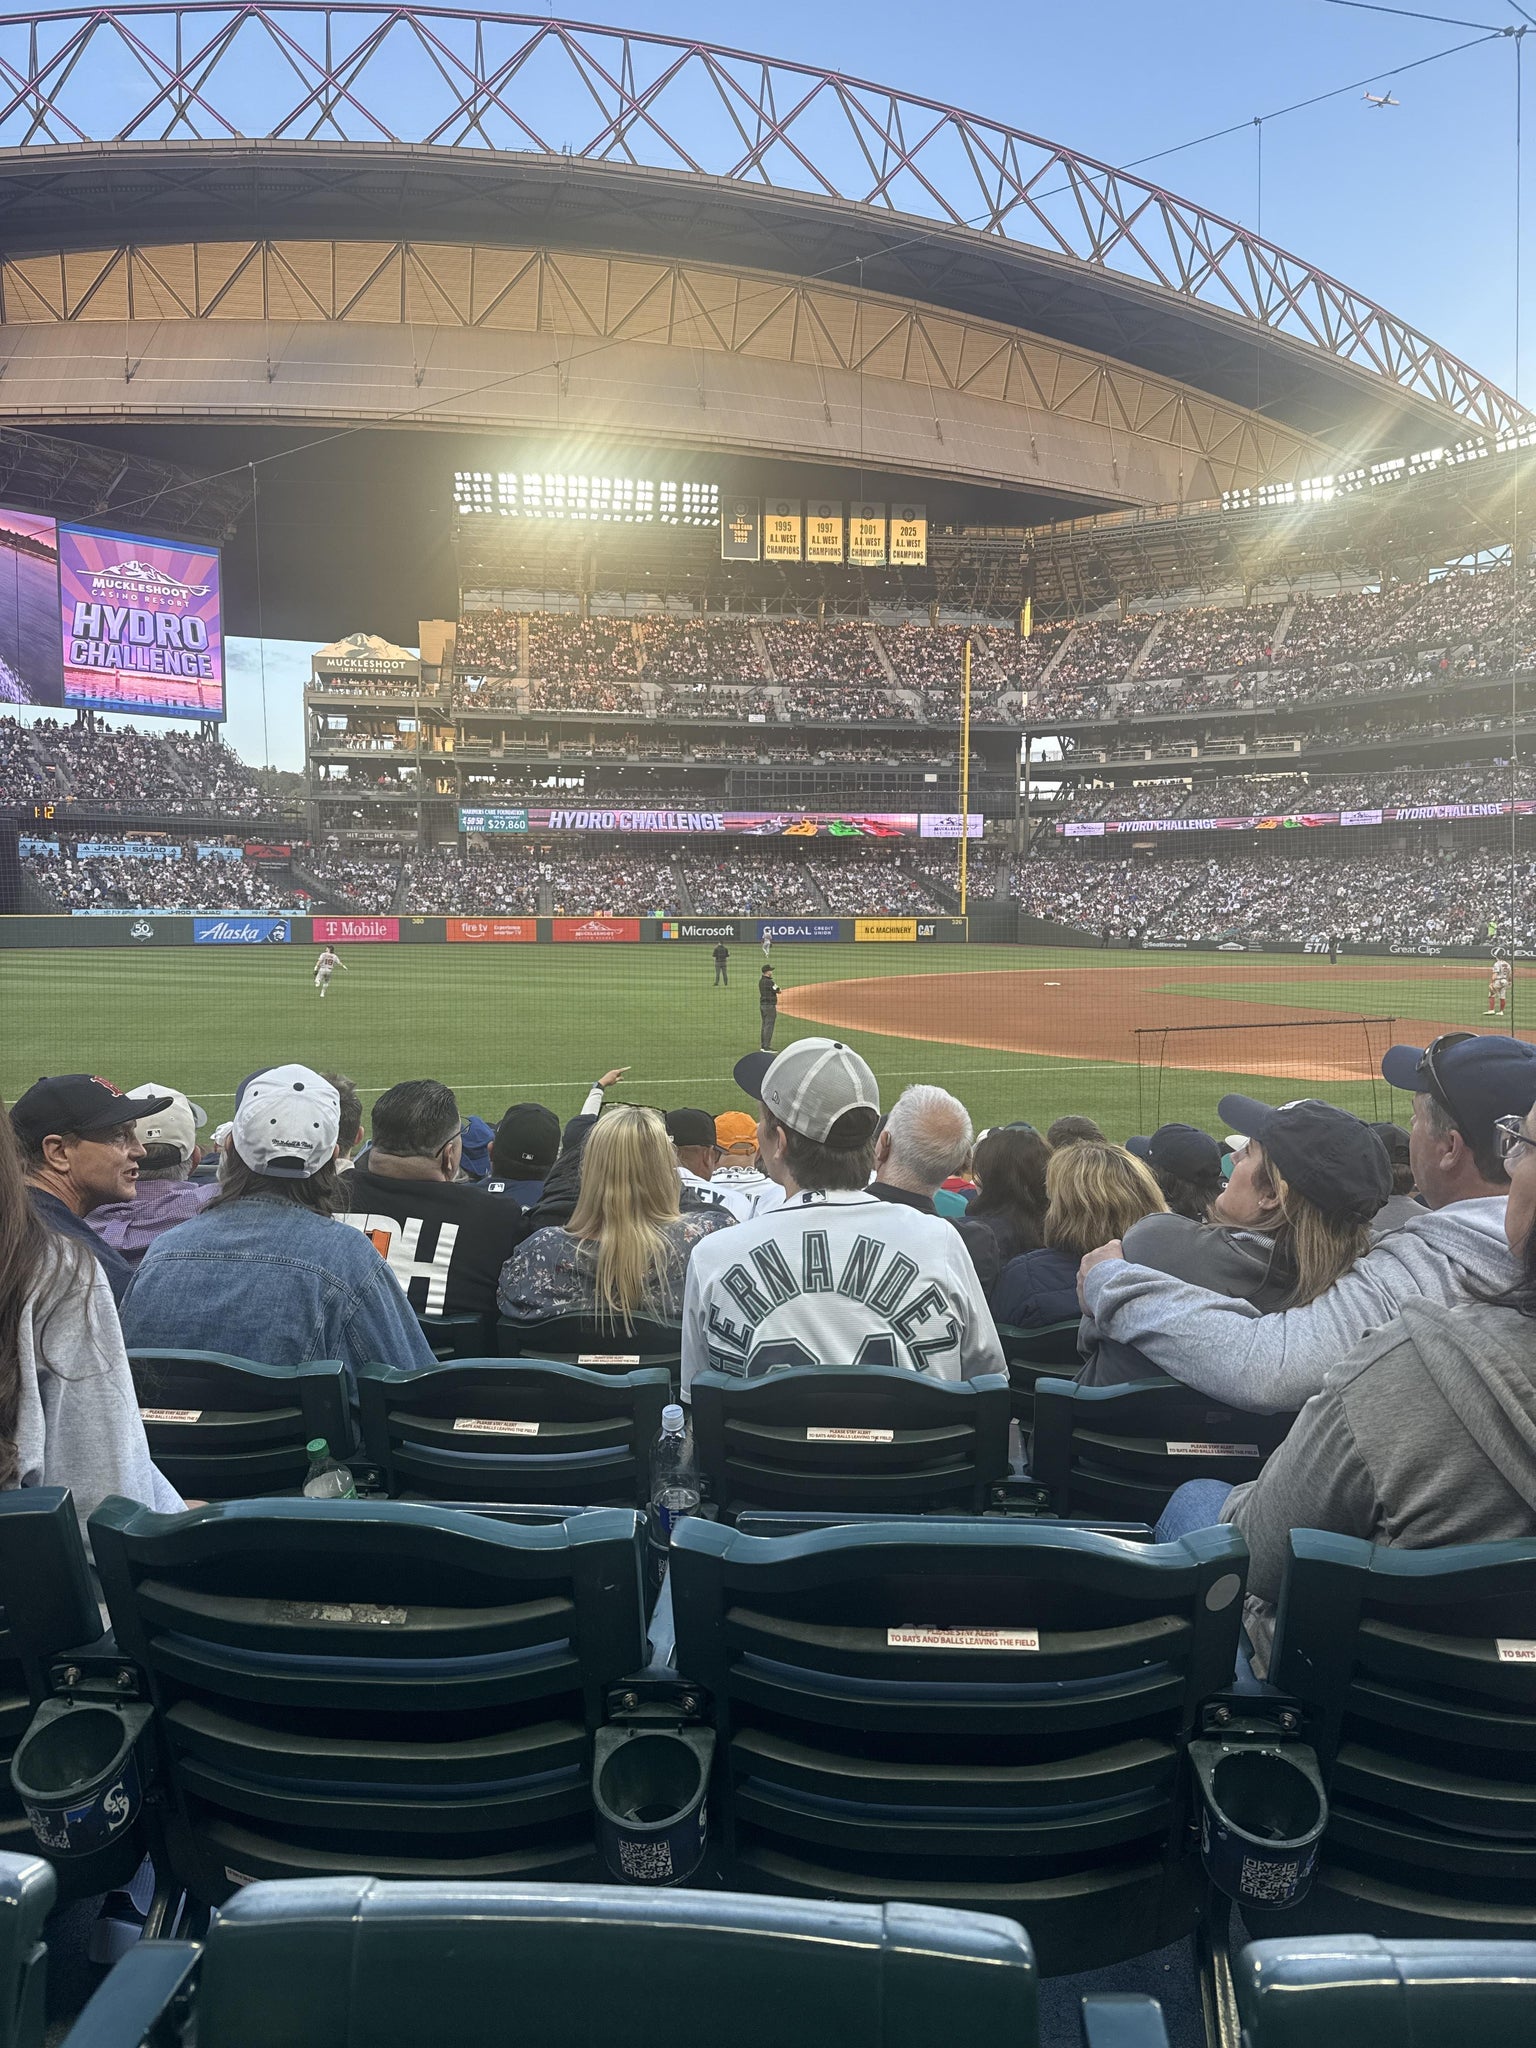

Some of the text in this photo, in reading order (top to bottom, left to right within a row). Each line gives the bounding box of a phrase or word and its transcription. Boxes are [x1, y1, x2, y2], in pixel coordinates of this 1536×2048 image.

[775, 521, 791, 532] 1995
[817, 523, 833, 533] 1997
[860, 524, 876, 535] 2001
[900, 526, 916, 537] 2025
[770, 534, 796, 543] A.L. WEST
[812, 535, 838, 545] A.L. WEST
[865, 538, 881, 547] WEST
[896, 539, 921, 548] A.L. WEST
[766, 545, 799, 555] CHAMPIONS
[809, 546, 841, 557] CHAMPIONS
[851, 548, 884, 558] CHAMPIONS
[893, 550, 924, 560] CHAMPIONS
[92, 577, 189, 600] MUCKLESHOOT
[92, 589, 190, 608] CASINO RESORT
[72, 601, 209, 652] HYDRO
[70, 639, 214, 679] CHALLENGE
[326, 658, 406, 669] MUCKLESHOOT
[1396, 803, 1504, 821] HYDRO CHALLENGE
[488, 820, 526, 830] $29,860
[548, 811, 726, 831] HYDRO CHALLENGE
[1118, 819, 1218, 833] HYDRO CHALLENGE
[135, 924, 150, 933] 50
[199, 922, 259, 941] Alaska
[341, 921, 387, 936] Mobile
[462, 923, 488, 931] fire tv
[681, 924, 734, 936] Microsoft
[763, 926, 811, 935] GLOBAL
[918, 925, 935, 936] CAT
[1389, 945, 1441, 956] Great Clips
[709, 1230, 965, 1378] HERNANDEZ
[903, 1635, 921, 1643] BATS
[941, 1636, 964, 1645] BALLS
[966, 1637, 998, 1646] LEAVING
[1015, 1639, 1036, 1647] FIELD
